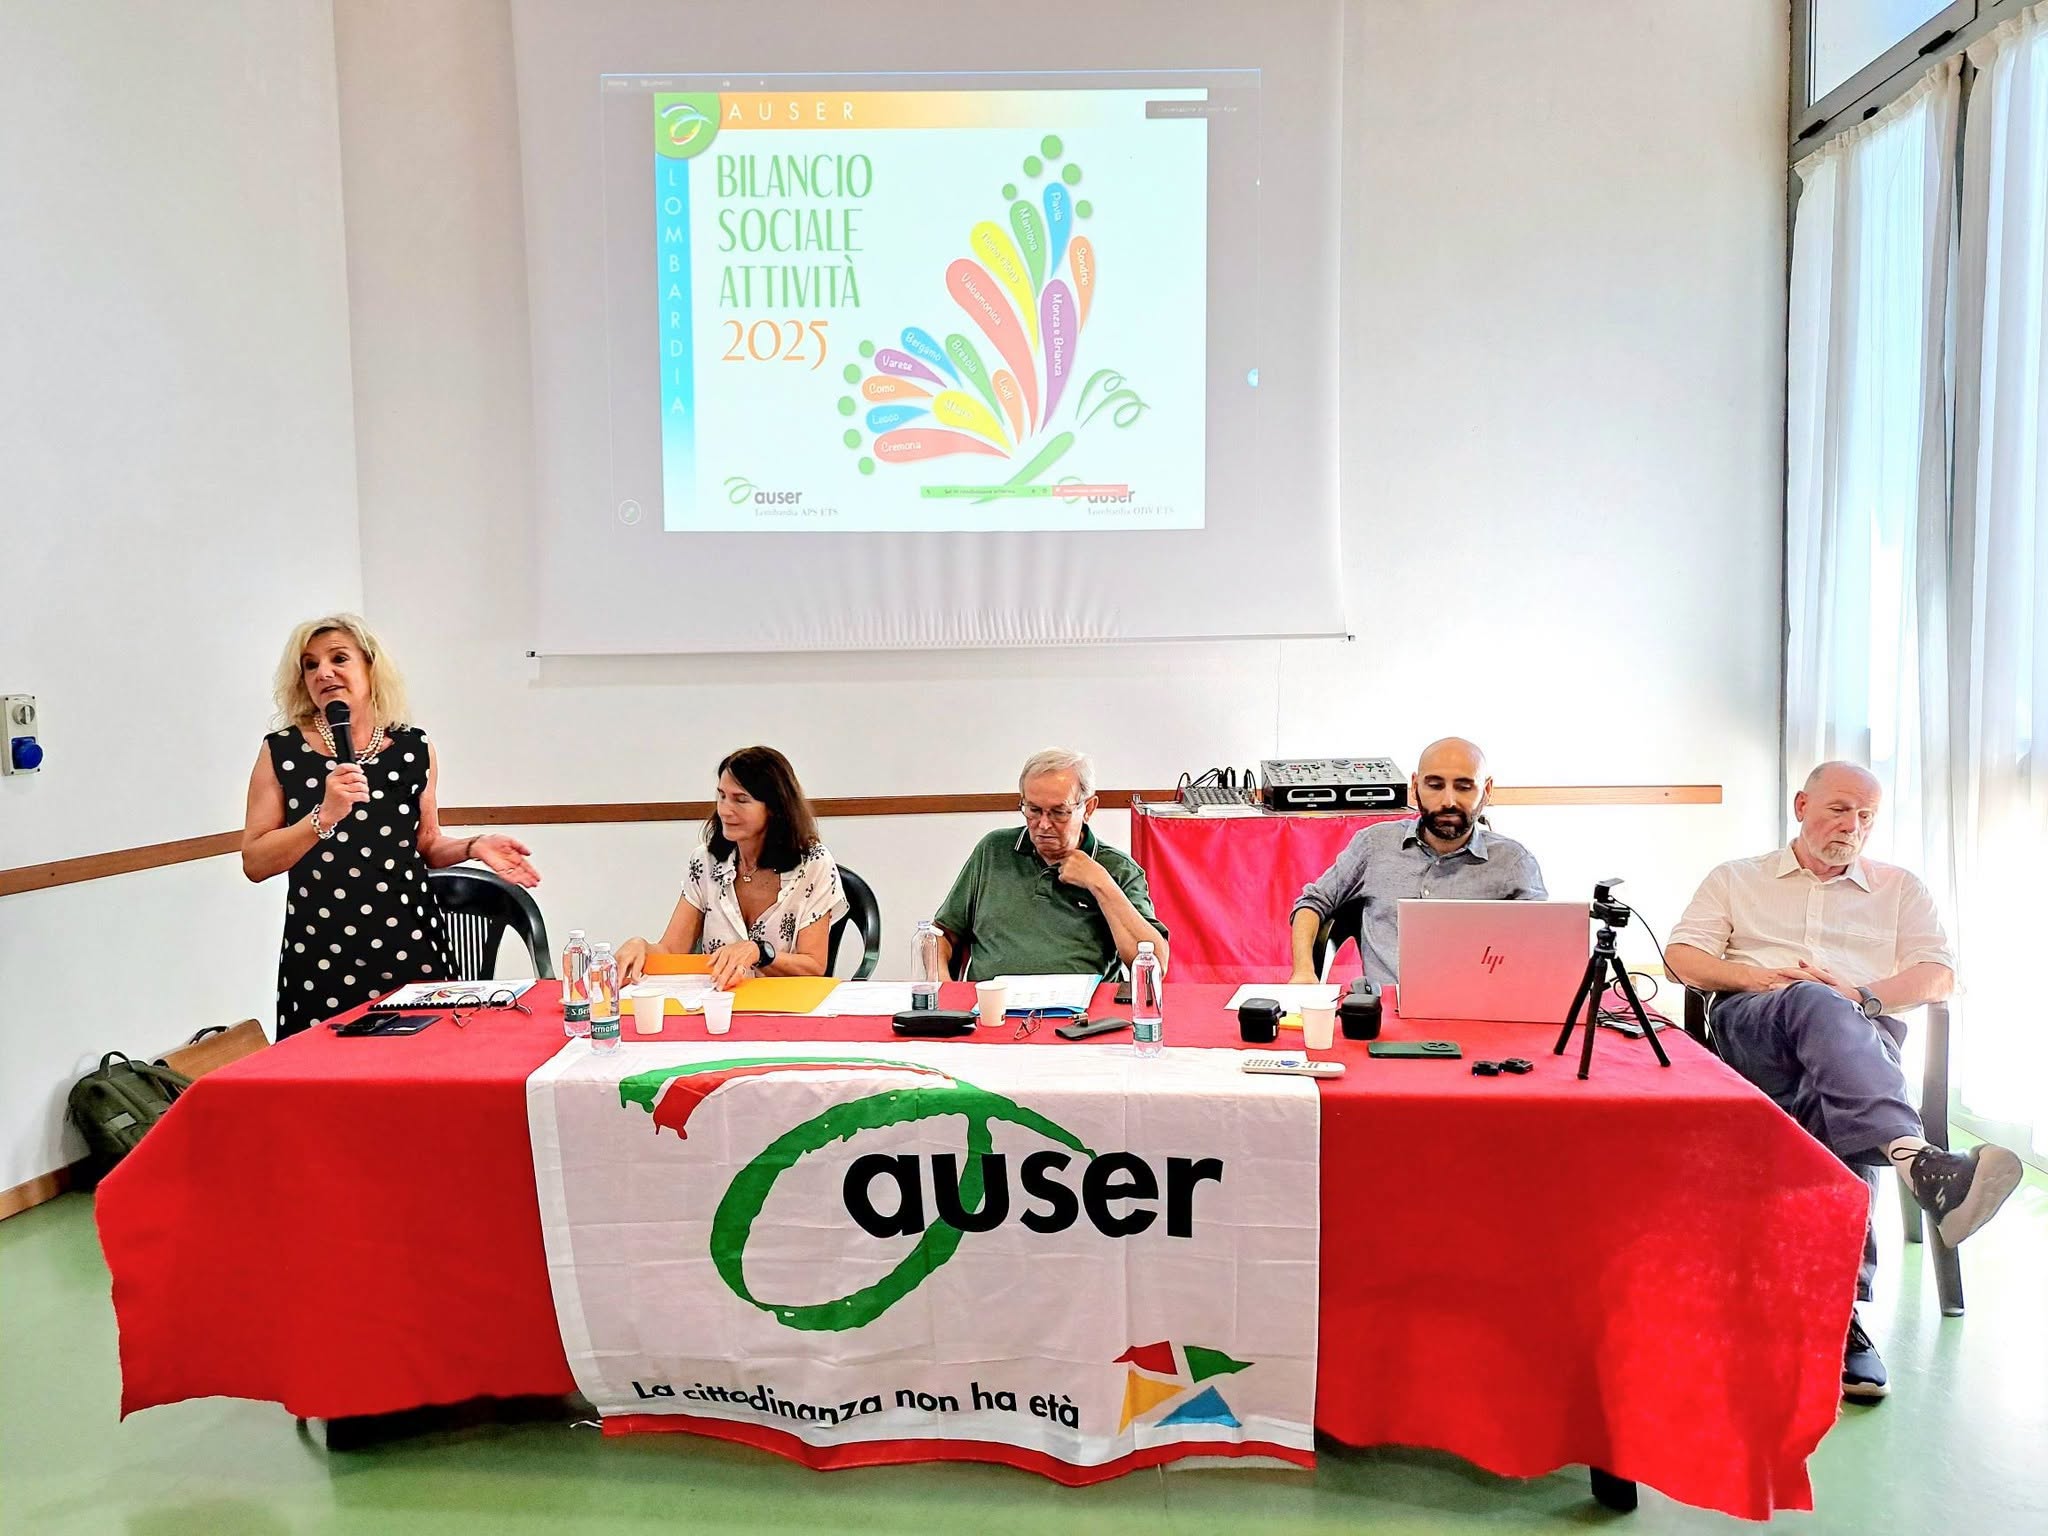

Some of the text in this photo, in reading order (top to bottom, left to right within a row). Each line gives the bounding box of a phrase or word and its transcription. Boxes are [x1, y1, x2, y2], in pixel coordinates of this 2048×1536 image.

[728, 102, 855, 121] AUSER
[716, 154, 873, 198] BILANCIO
[1051, 191, 1063, 222] Pavia
[718, 208, 864, 252] SOCIALE
[1019, 207, 1038, 253] Mantova
[719, 254, 861, 308] ATTIVITÀ
[1077, 247, 1089, 286] Sondrio
[664, 168, 687, 415] LOMBARDIA
[1052, 293, 1064, 328] Monza
[721, 319, 829, 371] 2025
[882, 355, 914, 371] Varese
[905, 332, 942, 362] Bergamo
[1053, 338, 1065, 377] Brianza
[869, 384, 896, 394] Como
[999, 377, 1014, 400] Lodi
[881, 441, 922, 452] Cremona
[754, 491, 803, 505] auser
[842, 1150, 1224, 1239] auser
[631, 1381, 1079, 1430] La cittadinanza non ha età
